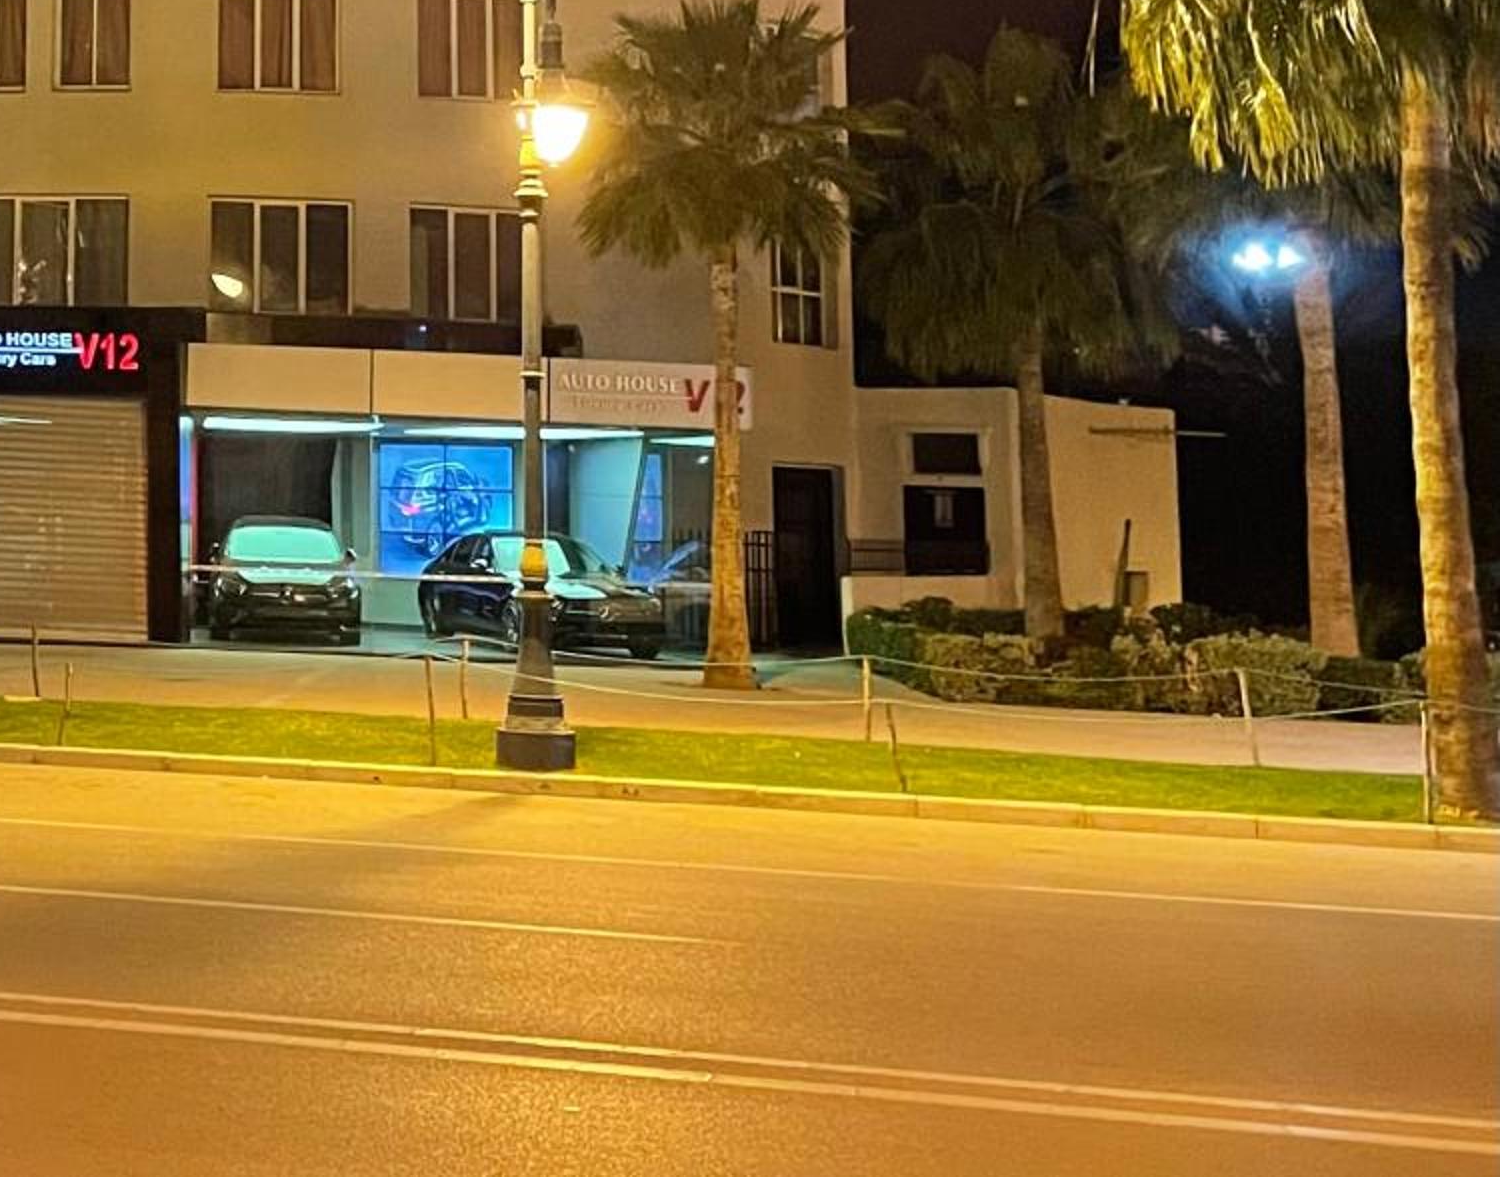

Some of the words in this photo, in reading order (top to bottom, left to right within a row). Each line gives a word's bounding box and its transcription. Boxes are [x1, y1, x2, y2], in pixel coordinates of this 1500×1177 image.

[6, 332, 73, 348] HOUSE
[74, 332, 139, 370] V12
[19, 352, 57, 367] Cars
[559, 374, 611, 391] AUTO
[615, 375, 678, 393] HOUSE
